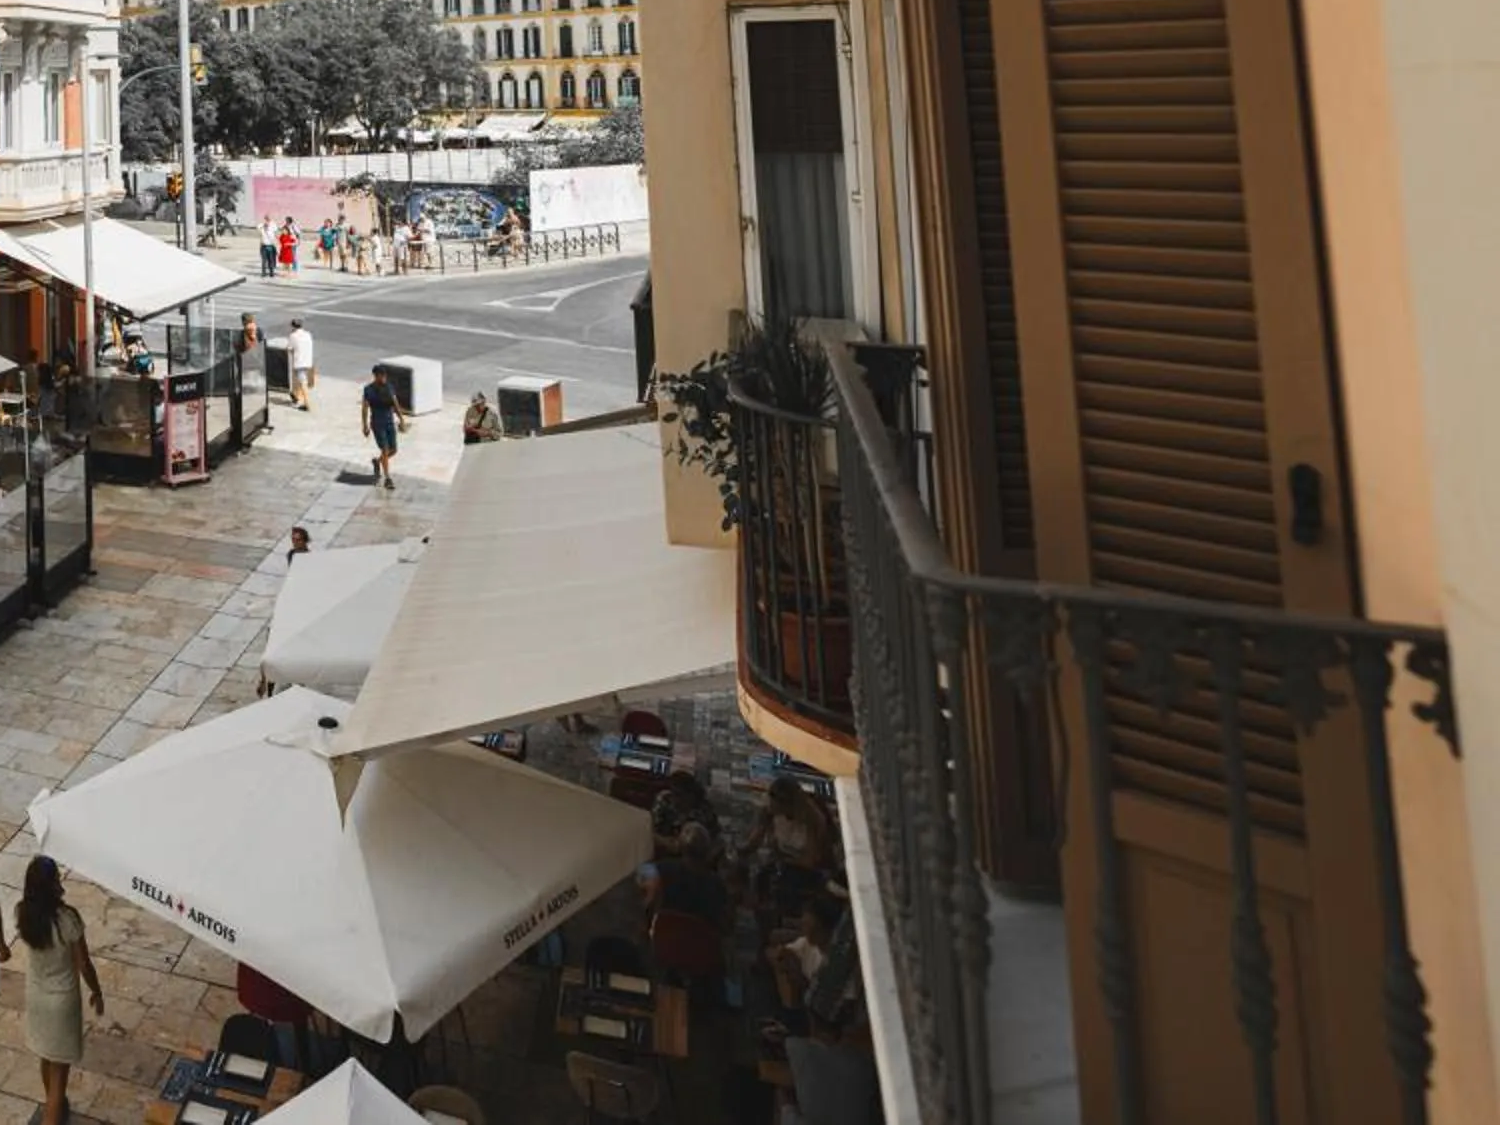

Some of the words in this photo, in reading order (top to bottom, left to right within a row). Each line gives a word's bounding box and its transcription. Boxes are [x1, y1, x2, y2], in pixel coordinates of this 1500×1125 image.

[131, 877, 173, 909] STELLA
[187, 907, 236, 944] ARTOIS
[503, 913, 537, 949] STELLA
[547, 884, 579, 916] ARTOIS
